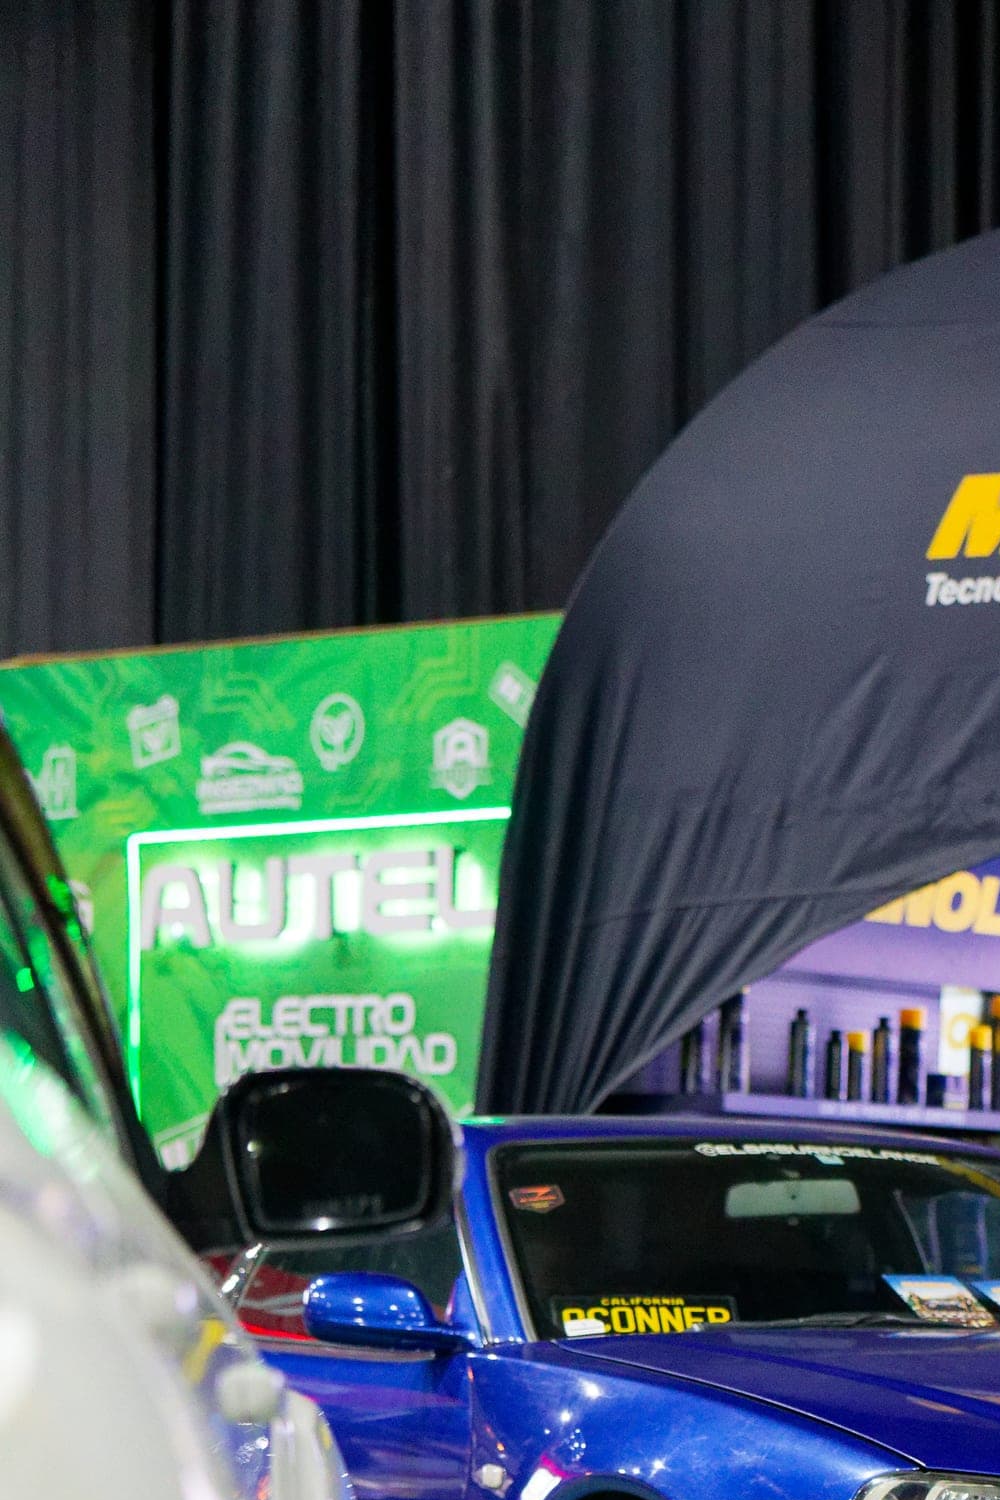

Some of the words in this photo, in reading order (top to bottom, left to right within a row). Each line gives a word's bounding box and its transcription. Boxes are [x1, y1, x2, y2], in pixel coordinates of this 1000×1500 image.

[140, 844, 497, 949] AUTEL
[222, 992, 416, 1040] ELECTRO
[226, 1033, 457, 1076] MOVILIDAD
[601, 1297, 685, 1306] CALIFORNIA
